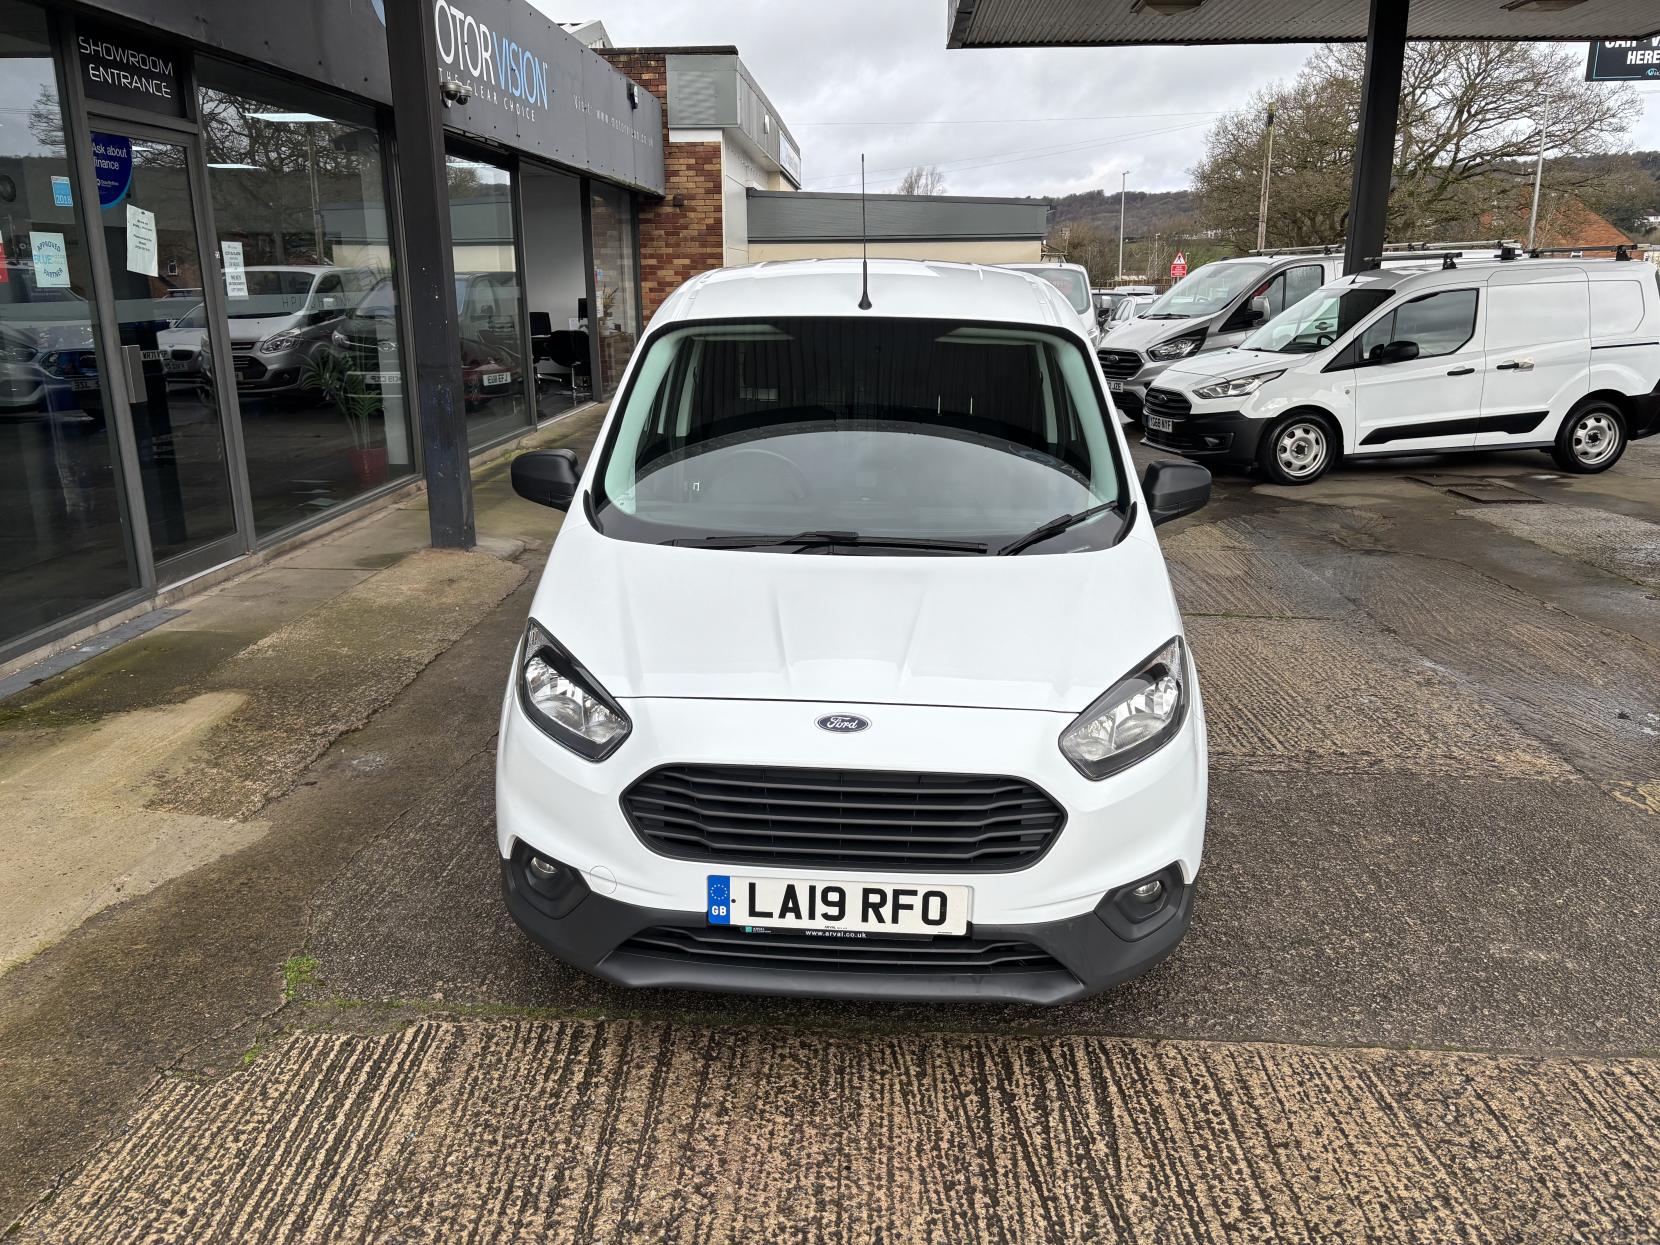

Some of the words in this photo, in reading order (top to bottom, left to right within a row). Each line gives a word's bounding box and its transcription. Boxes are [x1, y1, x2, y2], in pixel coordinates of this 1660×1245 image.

[79, 36, 174, 77] SHOWROOM
[434, 0, 549, 110] OTORVISION
[1626, 50, 1660, 64] HERE
[88, 63, 171, 98] ENTRANCE
[503, 97, 536, 122] CHOICE
[107, 145, 128, 158] about
[37, 241, 61, 252] APPROVED
[43, 267, 63, 278] PARTNER
[827, 716, 858, 729] Ford
[748, 881, 847, 923] LA19
[861, 887, 948, 926] RFO
[711, 905, 727, 916] GB
[805, 929, 867, 938] www.arval.co.uk
